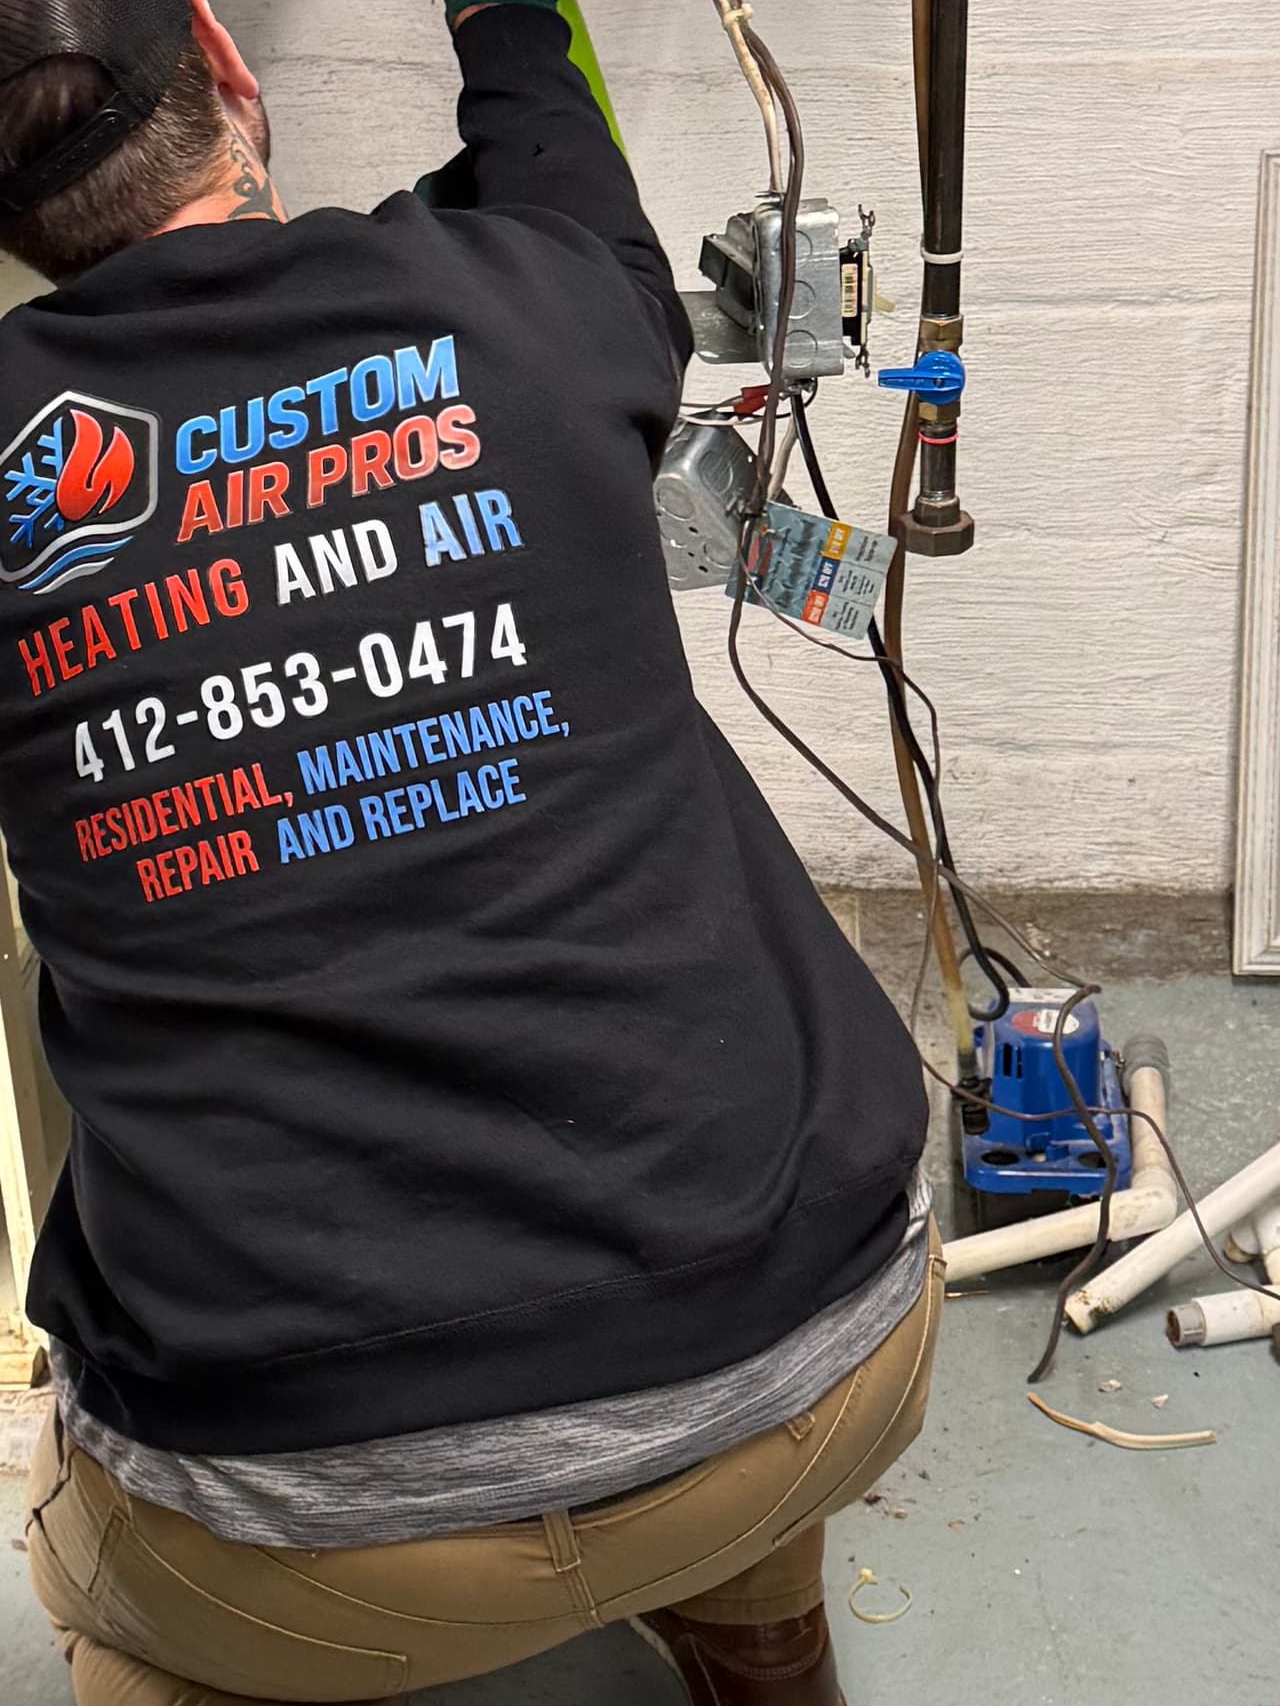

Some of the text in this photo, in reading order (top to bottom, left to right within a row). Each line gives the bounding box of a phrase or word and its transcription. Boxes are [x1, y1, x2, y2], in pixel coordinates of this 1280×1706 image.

[174, 334, 462, 476] CUSTOM
[175, 403, 482, 544] AIR PROS
[17, 487, 525, 698] HEATING AND AIR
[73, 602, 528, 783] 412-853-0474
[74, 689, 571, 864] RESIDENTIAL, MAINTENANCE,
[135, 757, 527, 904] REPAIR AND REPLACE
